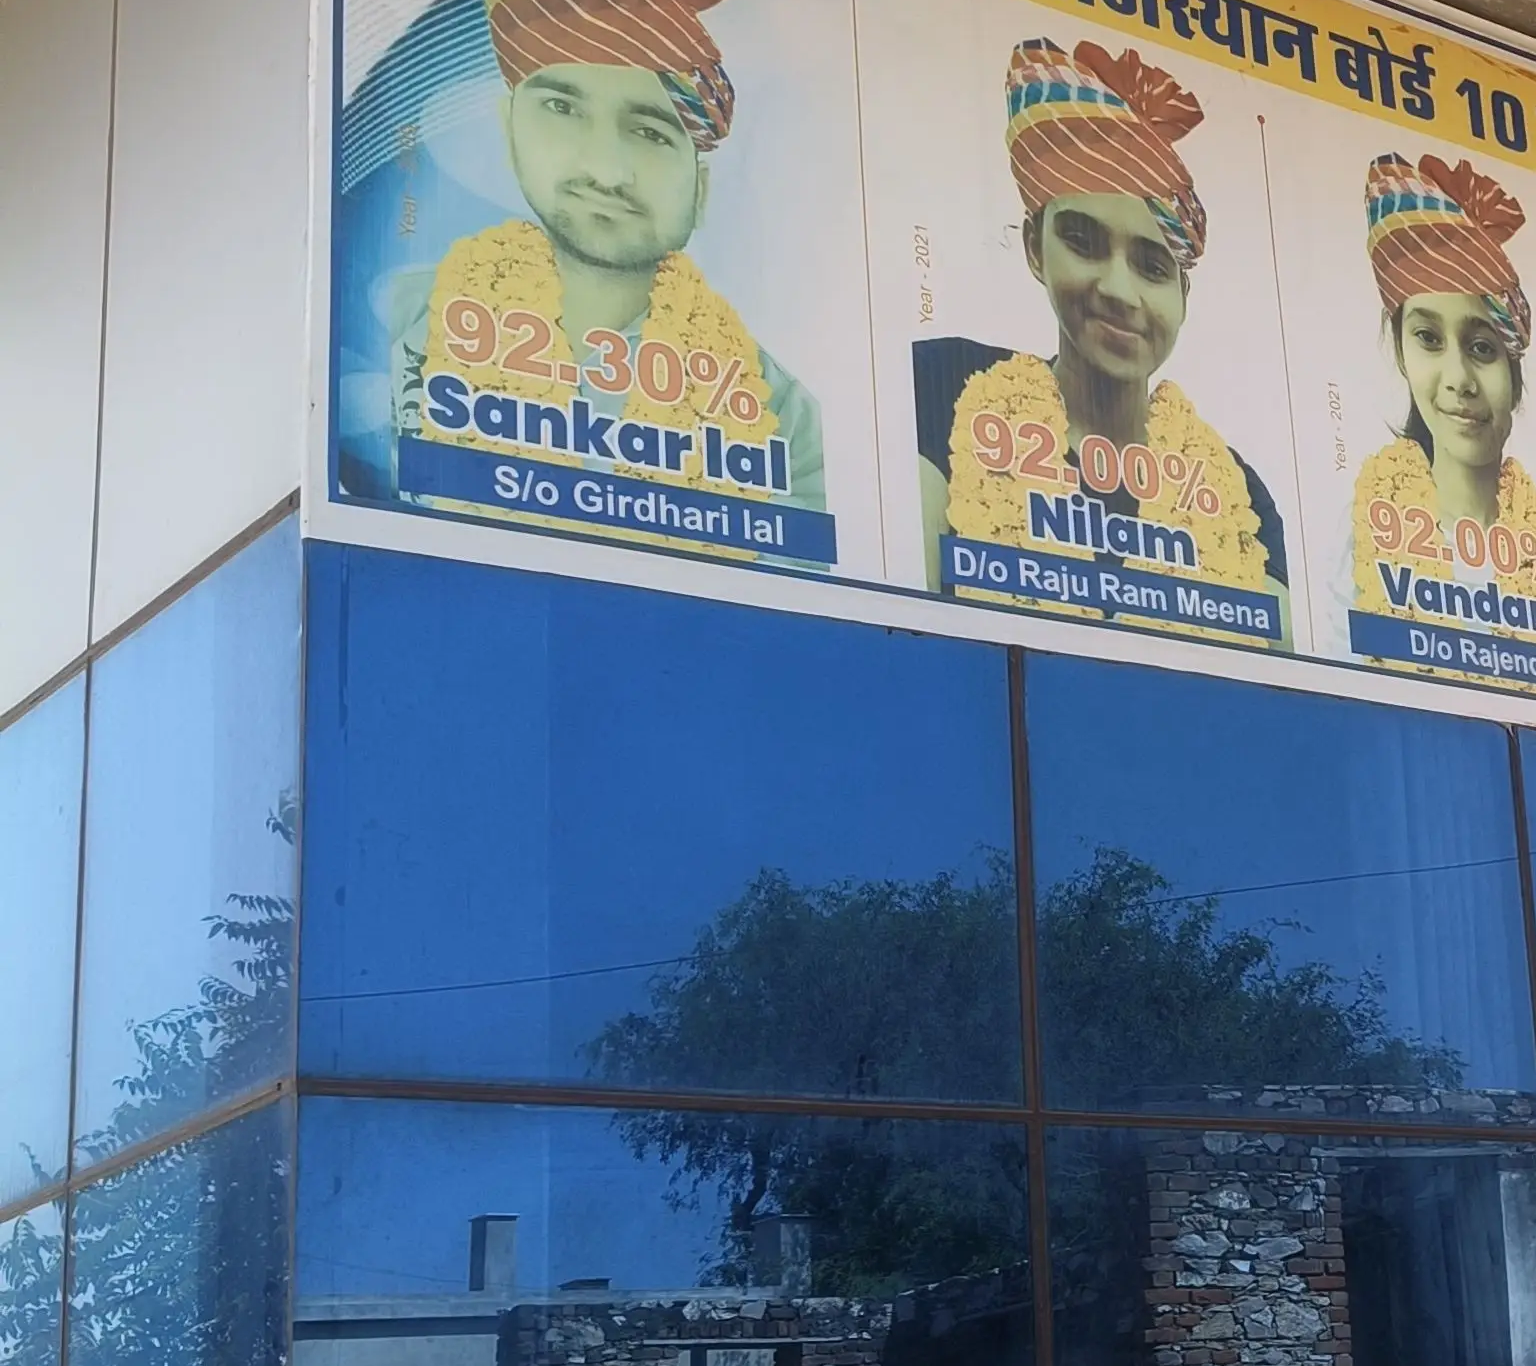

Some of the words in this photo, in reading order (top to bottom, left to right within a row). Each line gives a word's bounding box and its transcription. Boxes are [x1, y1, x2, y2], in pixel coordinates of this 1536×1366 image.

[1328, 27, 1437, 123] बोर्ड
[1456, 78, 1527, 153] 10
[914, 224, 930, 269] 2021
[920, 285, 934, 324] Year
[443, 299, 762, 424] 92.30%
[427, 375, 693, 473] Sankar
[704, 427, 790, 495] lal
[1329, 382, 1342, 423] 2021
[971, 412, 1221, 517] 92.00%
[1335, 436, 1348, 472] Year
[494, 465, 560, 507] S/o
[572, 479, 733, 537] Girdhari
[743, 506, 785, 546] lal
[1029, 491, 1198, 570] Nilam
[953, 546, 1008, 583] D/o
[1019, 558, 1089, 601] Raju
[1100, 571, 1167, 611] Ram
[1177, 586, 1270, 631] Meena
[1409, 629, 1453, 661] D/o
